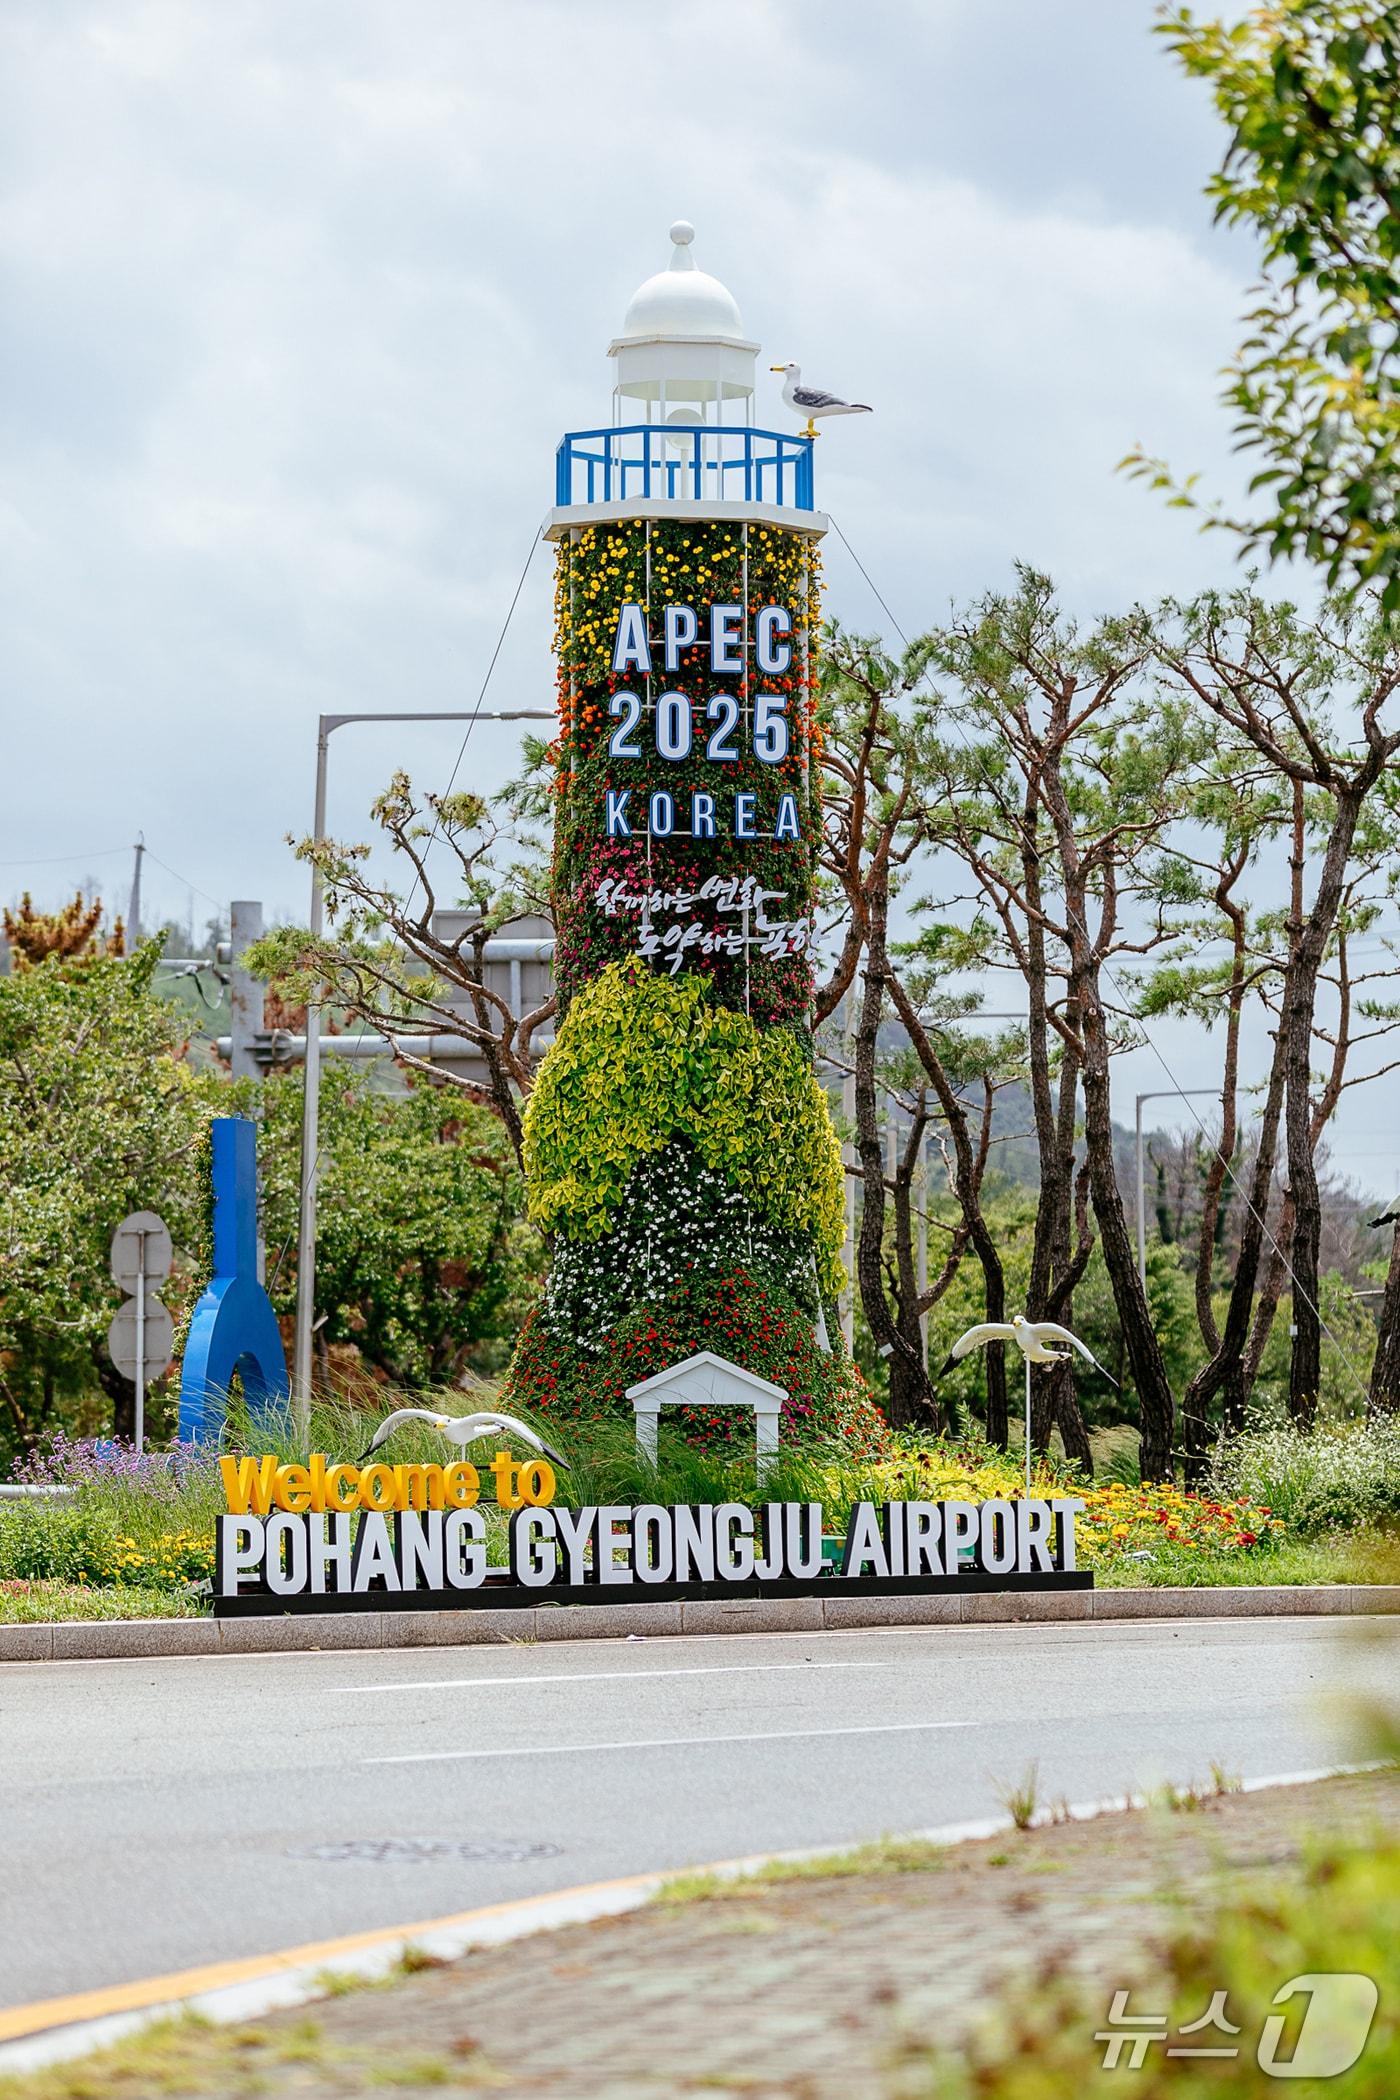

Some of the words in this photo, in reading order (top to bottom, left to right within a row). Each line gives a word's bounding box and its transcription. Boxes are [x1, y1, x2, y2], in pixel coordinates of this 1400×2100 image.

[612, 604, 792, 674] APEC
[607, 690, 790, 764] 2025
[605, 789, 800, 840] KOREA
[595, 878, 694, 914] 함께하는
[698, 875, 789, 912] 변화
[635, 922, 746, 976] 도약하는
[755, 914, 831, 962] 포항
[219, 1453, 480, 1514] Welcome
[490, 1451, 556, 1509] to
[219, 1509, 487, 1597] POHANG
[513, 1502, 823, 1588] GYEONGJU
[847, 1499, 1086, 1577] AIRPORT
